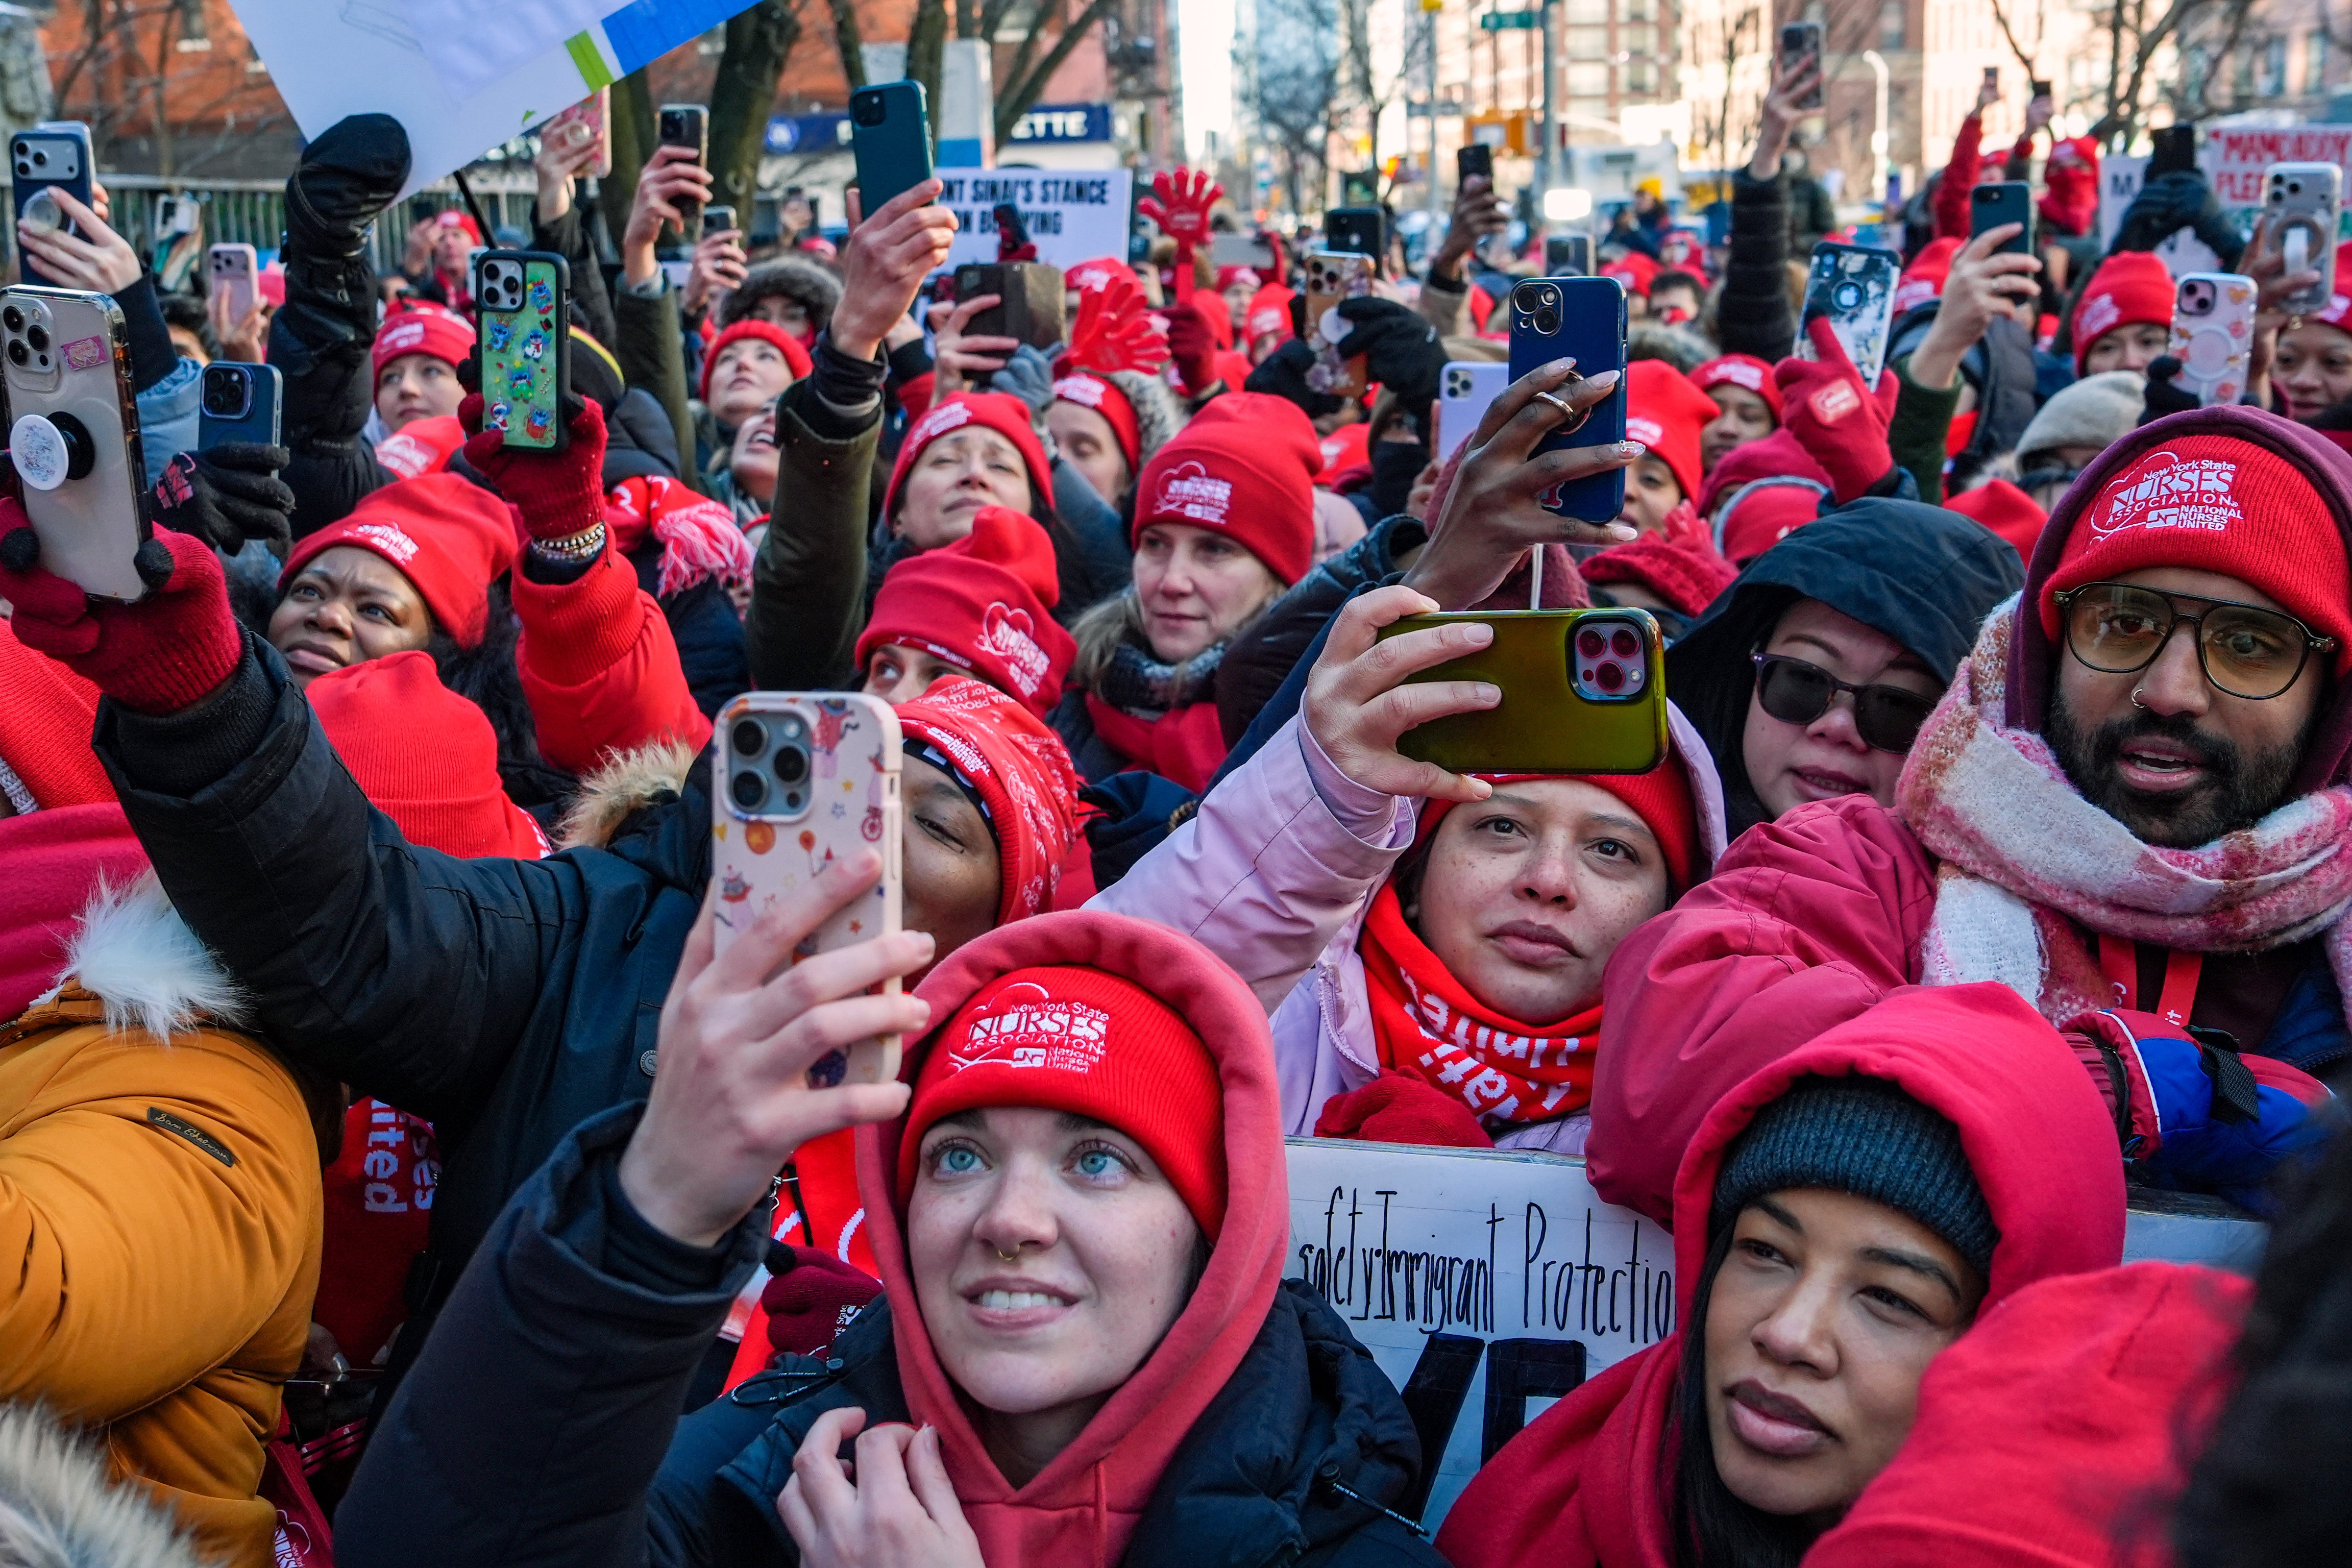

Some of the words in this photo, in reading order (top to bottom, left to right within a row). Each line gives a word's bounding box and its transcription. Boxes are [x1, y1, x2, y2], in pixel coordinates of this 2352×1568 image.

[1041, 179, 1109, 204] STANCE
[2143, 465, 2170, 481] New
[2170, 459, 2199, 473] York
[2199, 459, 2236, 471] State
[2110, 469, 2234, 516] NURSES
[2178, 511, 2228, 524] NURSES
[2180, 503, 2244, 520] NATIONAL
[2178, 519, 2225, 531] UNITED
[1010, 1003, 1039, 1014] New
[1039, 1001, 1069, 1013] York
[1072, 1001, 1110, 1021] State
[968, 1011, 1107, 1043] NURSES
[154, 1112, 182, 1130] Sam
[364, 1099, 407, 1212] ited
[1524, 1202, 1676, 1343] Protectio
[836, 1305, 847, 1325] State
[832, 1327, 843, 1341] ork
